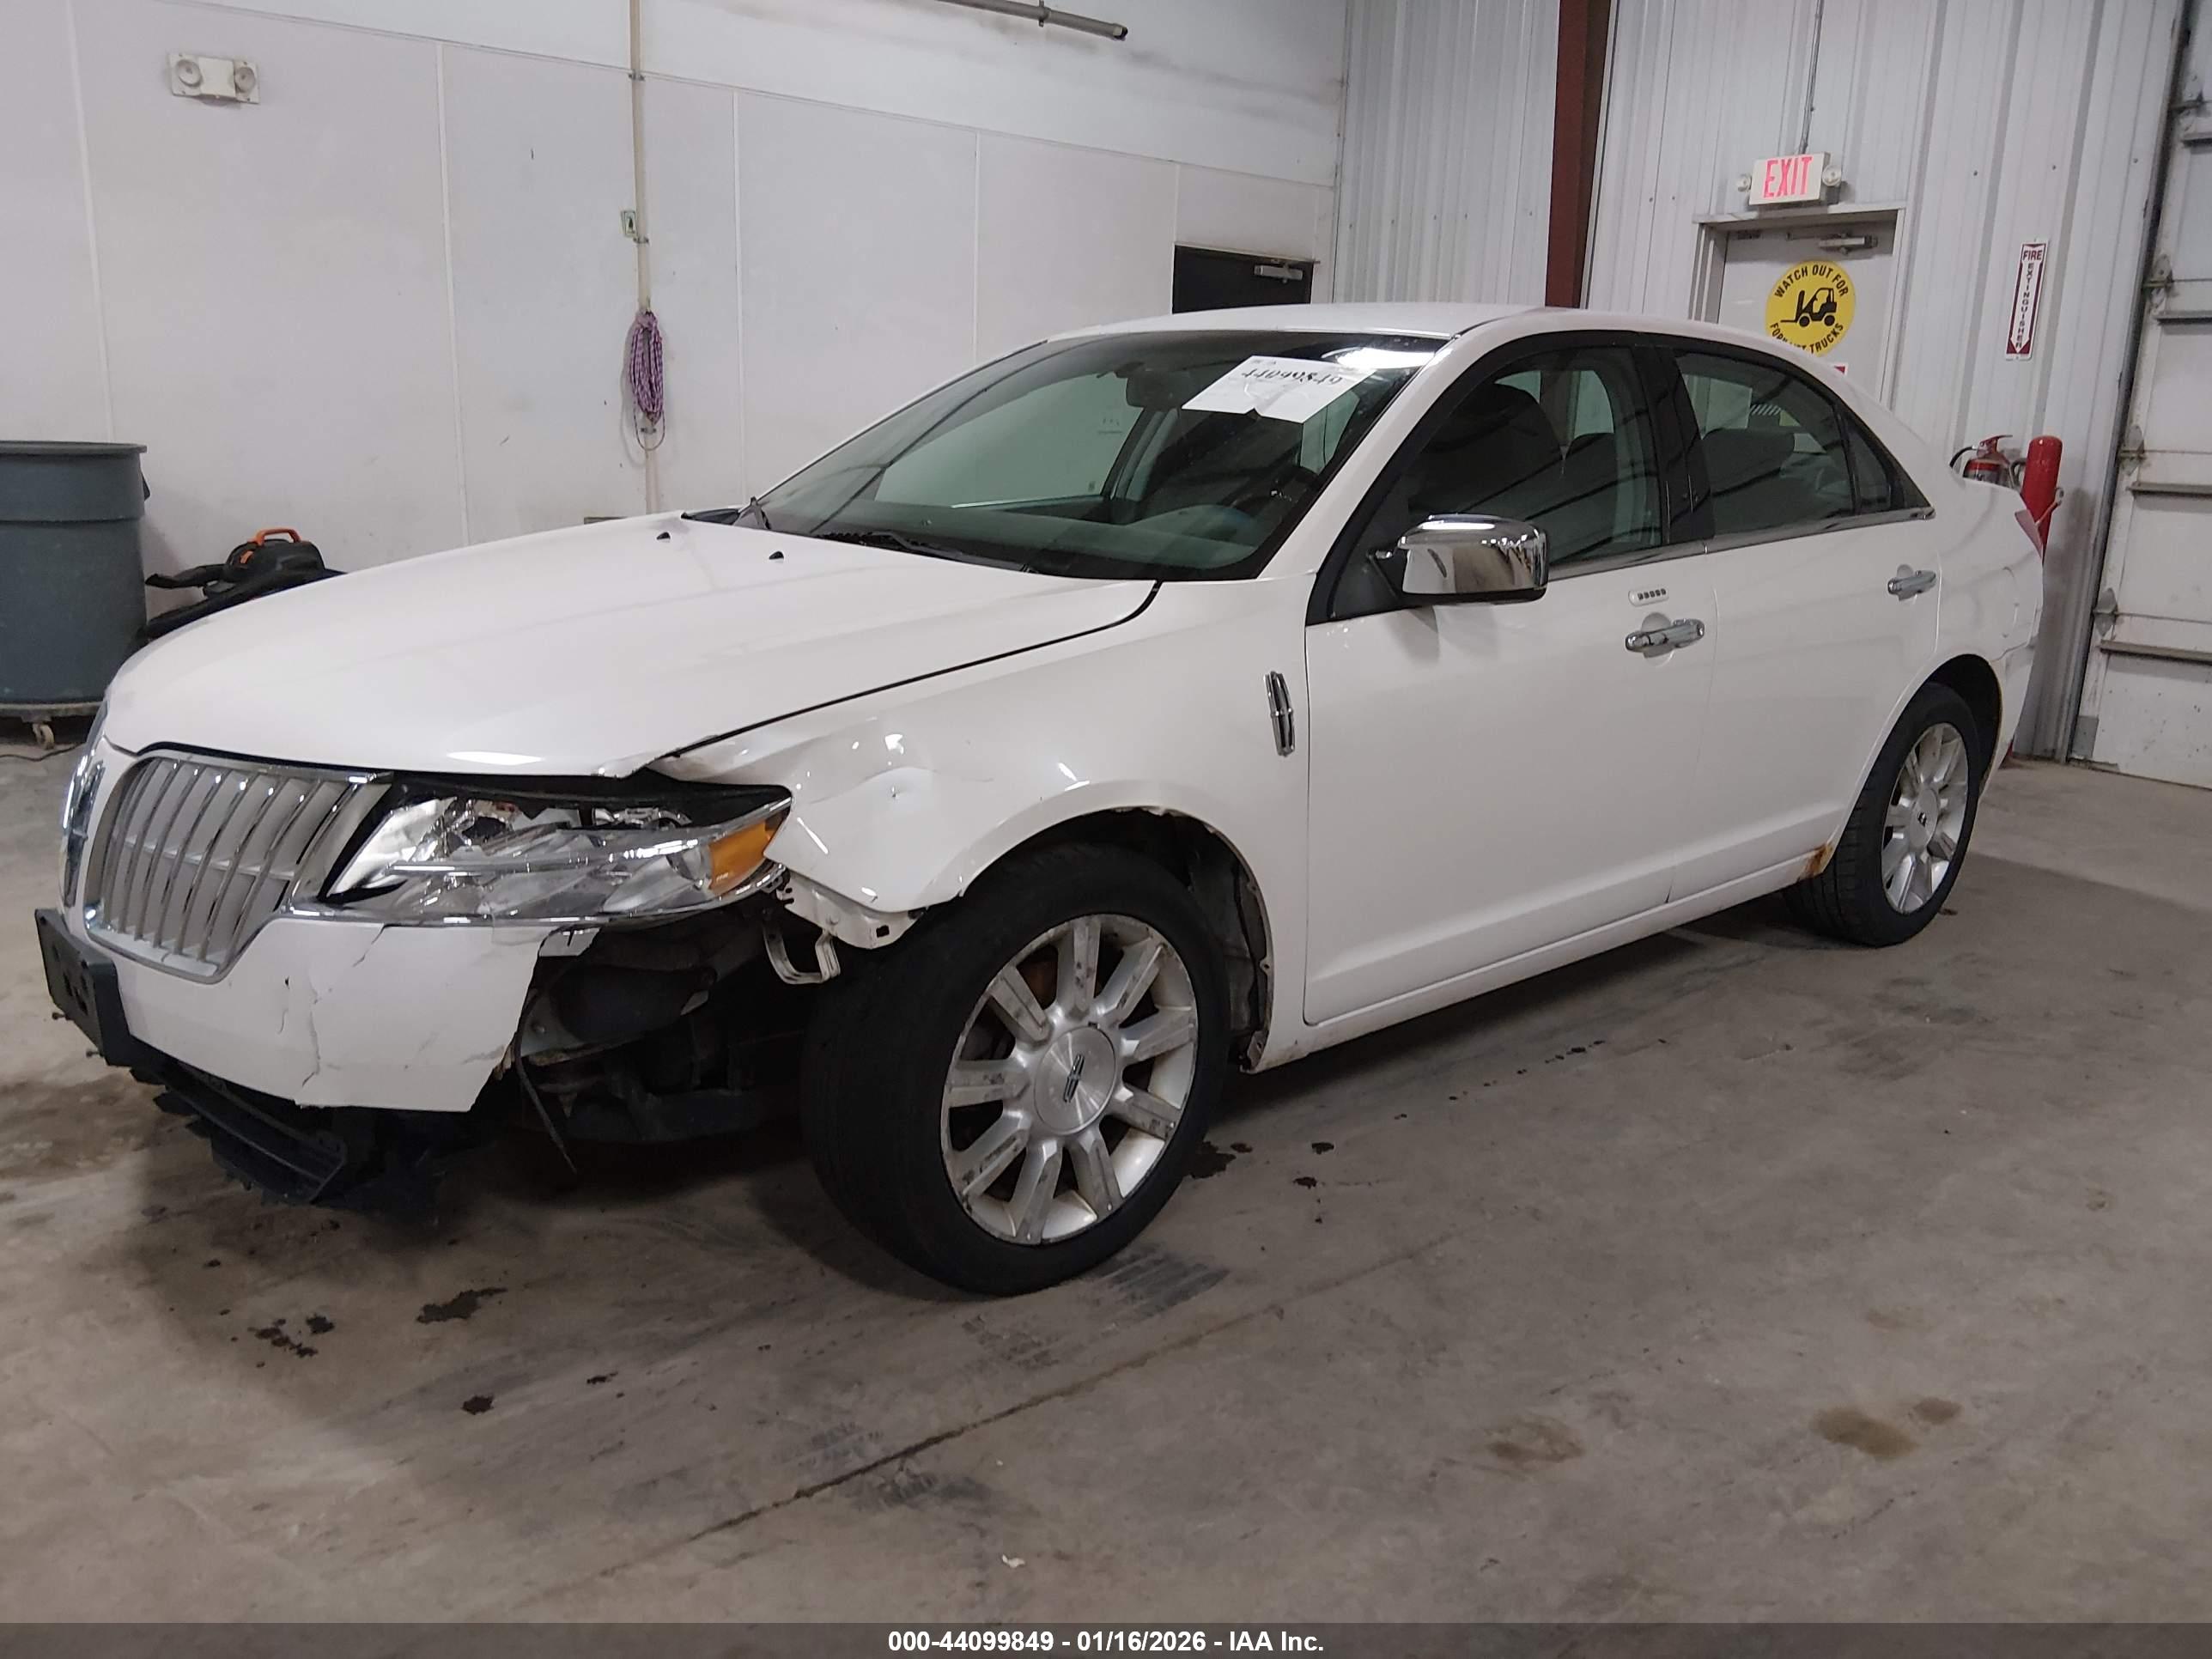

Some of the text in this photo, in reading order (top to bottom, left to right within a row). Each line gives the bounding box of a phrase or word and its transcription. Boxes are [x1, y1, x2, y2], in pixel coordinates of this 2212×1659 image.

[1764, 156, 1814, 198] EXIT
[2022, 250, 2043, 261] FIRE
[1774, 264, 1849, 298] WATCH OUT FOR
[2015, 262, 2034, 349] EXTINGUISHER
[1809, 323, 1844, 354] TRUCKS
